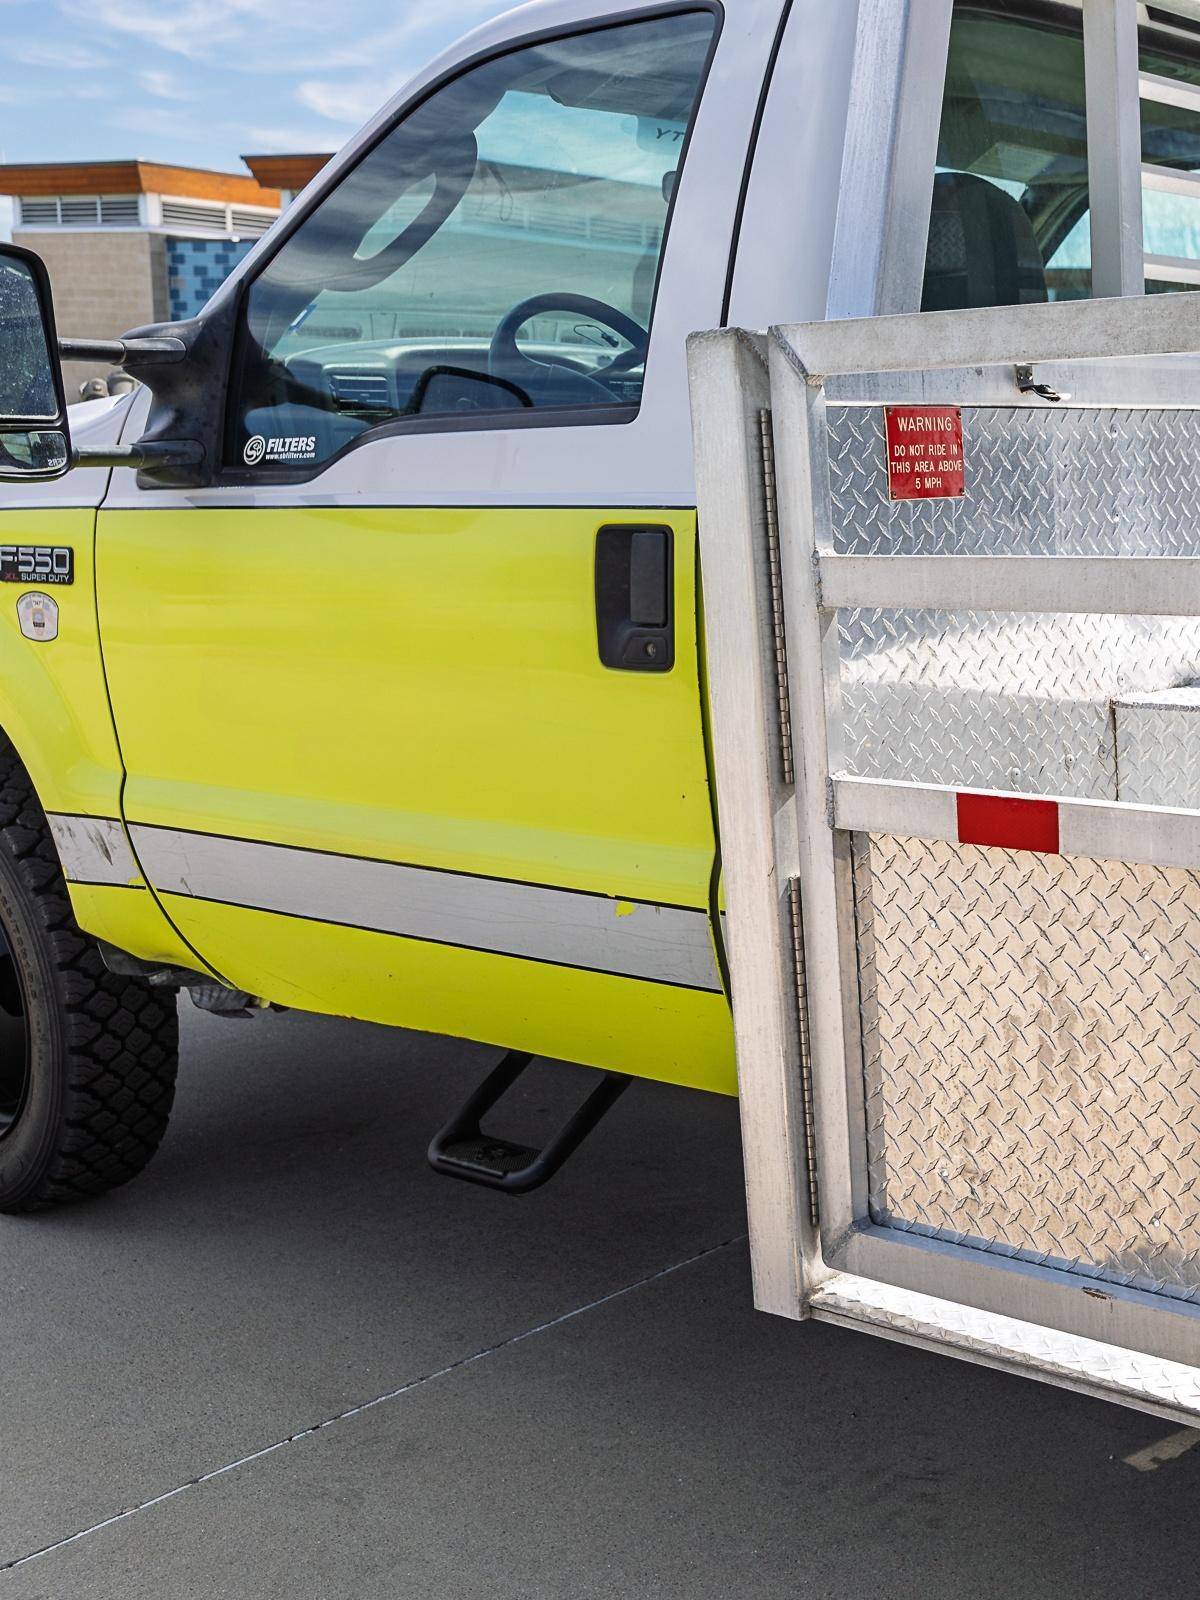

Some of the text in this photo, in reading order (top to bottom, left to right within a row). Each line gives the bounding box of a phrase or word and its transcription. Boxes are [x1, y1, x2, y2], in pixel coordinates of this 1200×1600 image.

[897, 416, 952, 432] WARNING
[266, 436, 316, 453] FILTERS
[894, 443, 958, 457] DO NOT RIDE IN
[891, 459, 962, 474] THIS AREA ABOVE
[915, 477, 942, 489] 5 MPH
[21, 572, 47, 582] SUPER
[48, 574, 70, 583] DUTY
